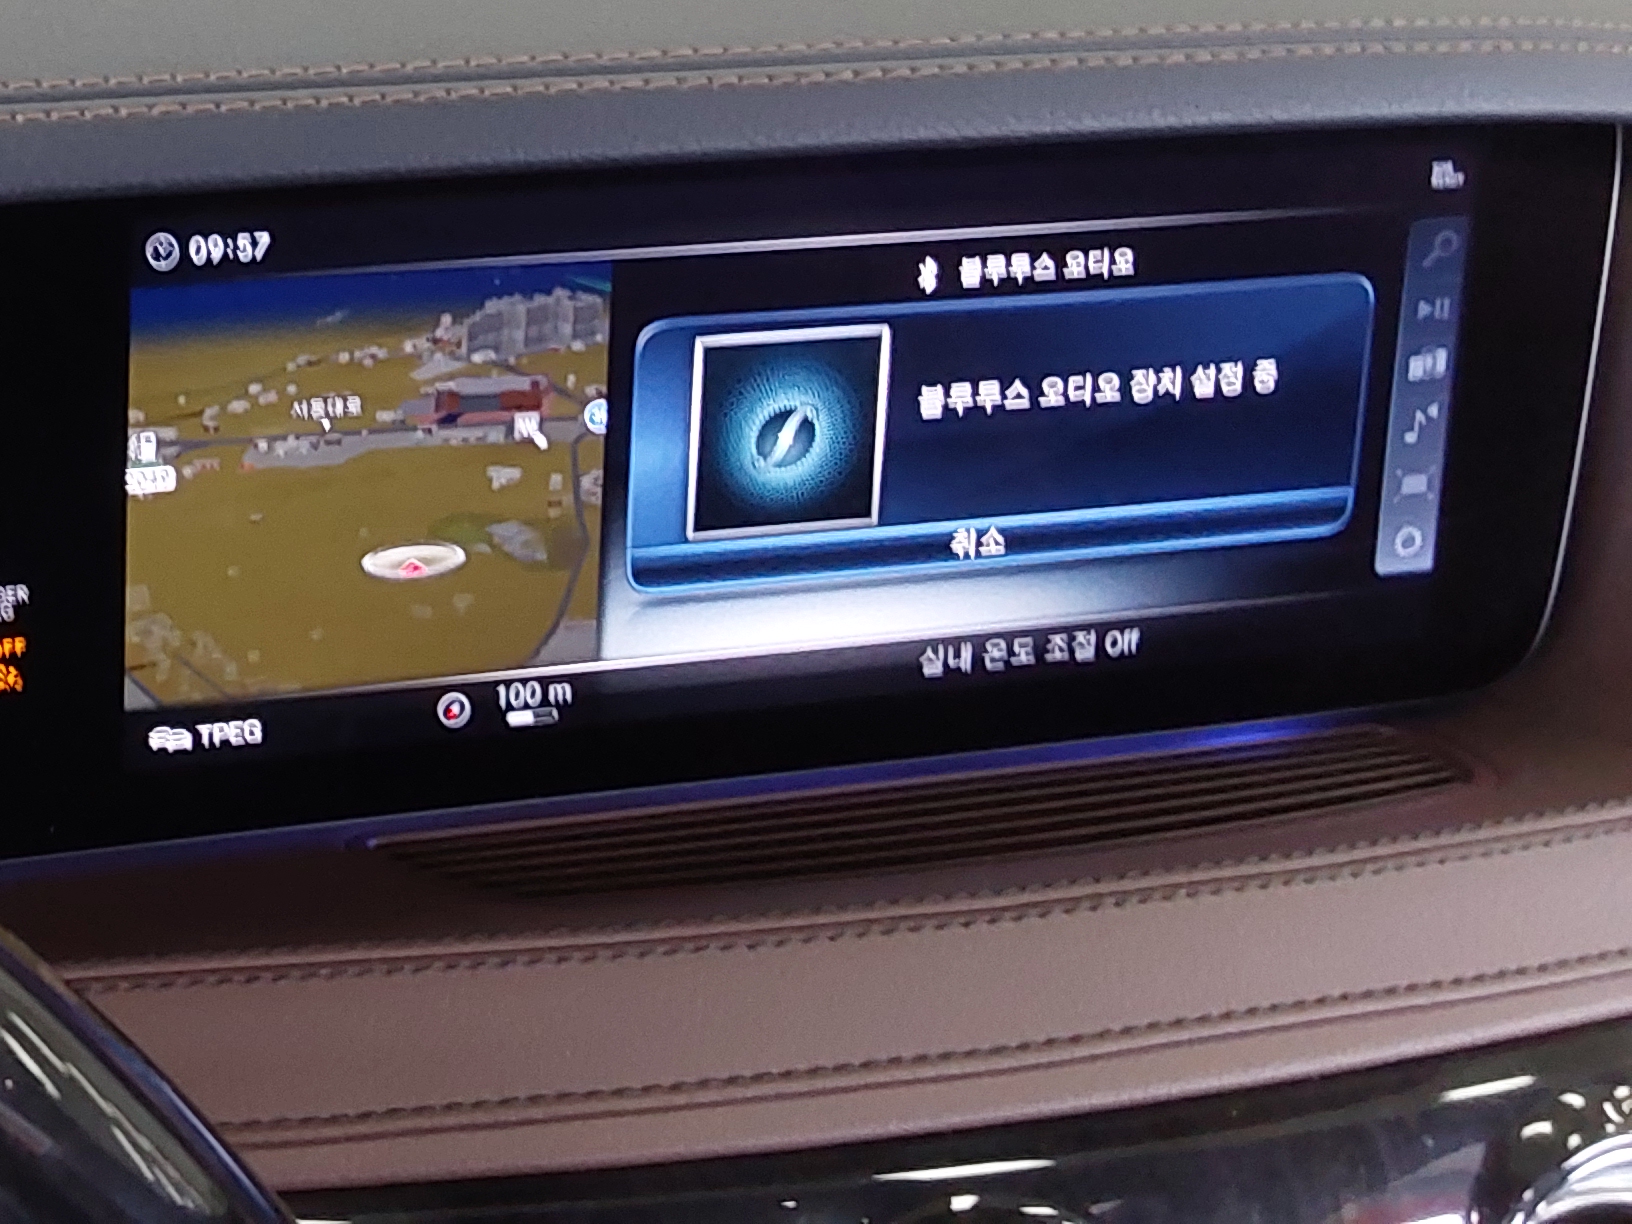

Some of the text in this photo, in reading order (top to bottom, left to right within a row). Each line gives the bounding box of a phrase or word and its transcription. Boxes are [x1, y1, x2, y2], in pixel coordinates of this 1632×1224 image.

[188, 230, 271, 267] 09:57
[958, 246, 1135, 288] 블루투스 오디오
[918, 357, 1279, 420] 블루투스 오디오 장치 설정 중
[949, 525, 1007, 561] 취소
[919, 626, 1141, 679] 실내 온도 조절 Off
[496, 679, 574, 709] 100 m
[195, 717, 263, 750] TPEG
